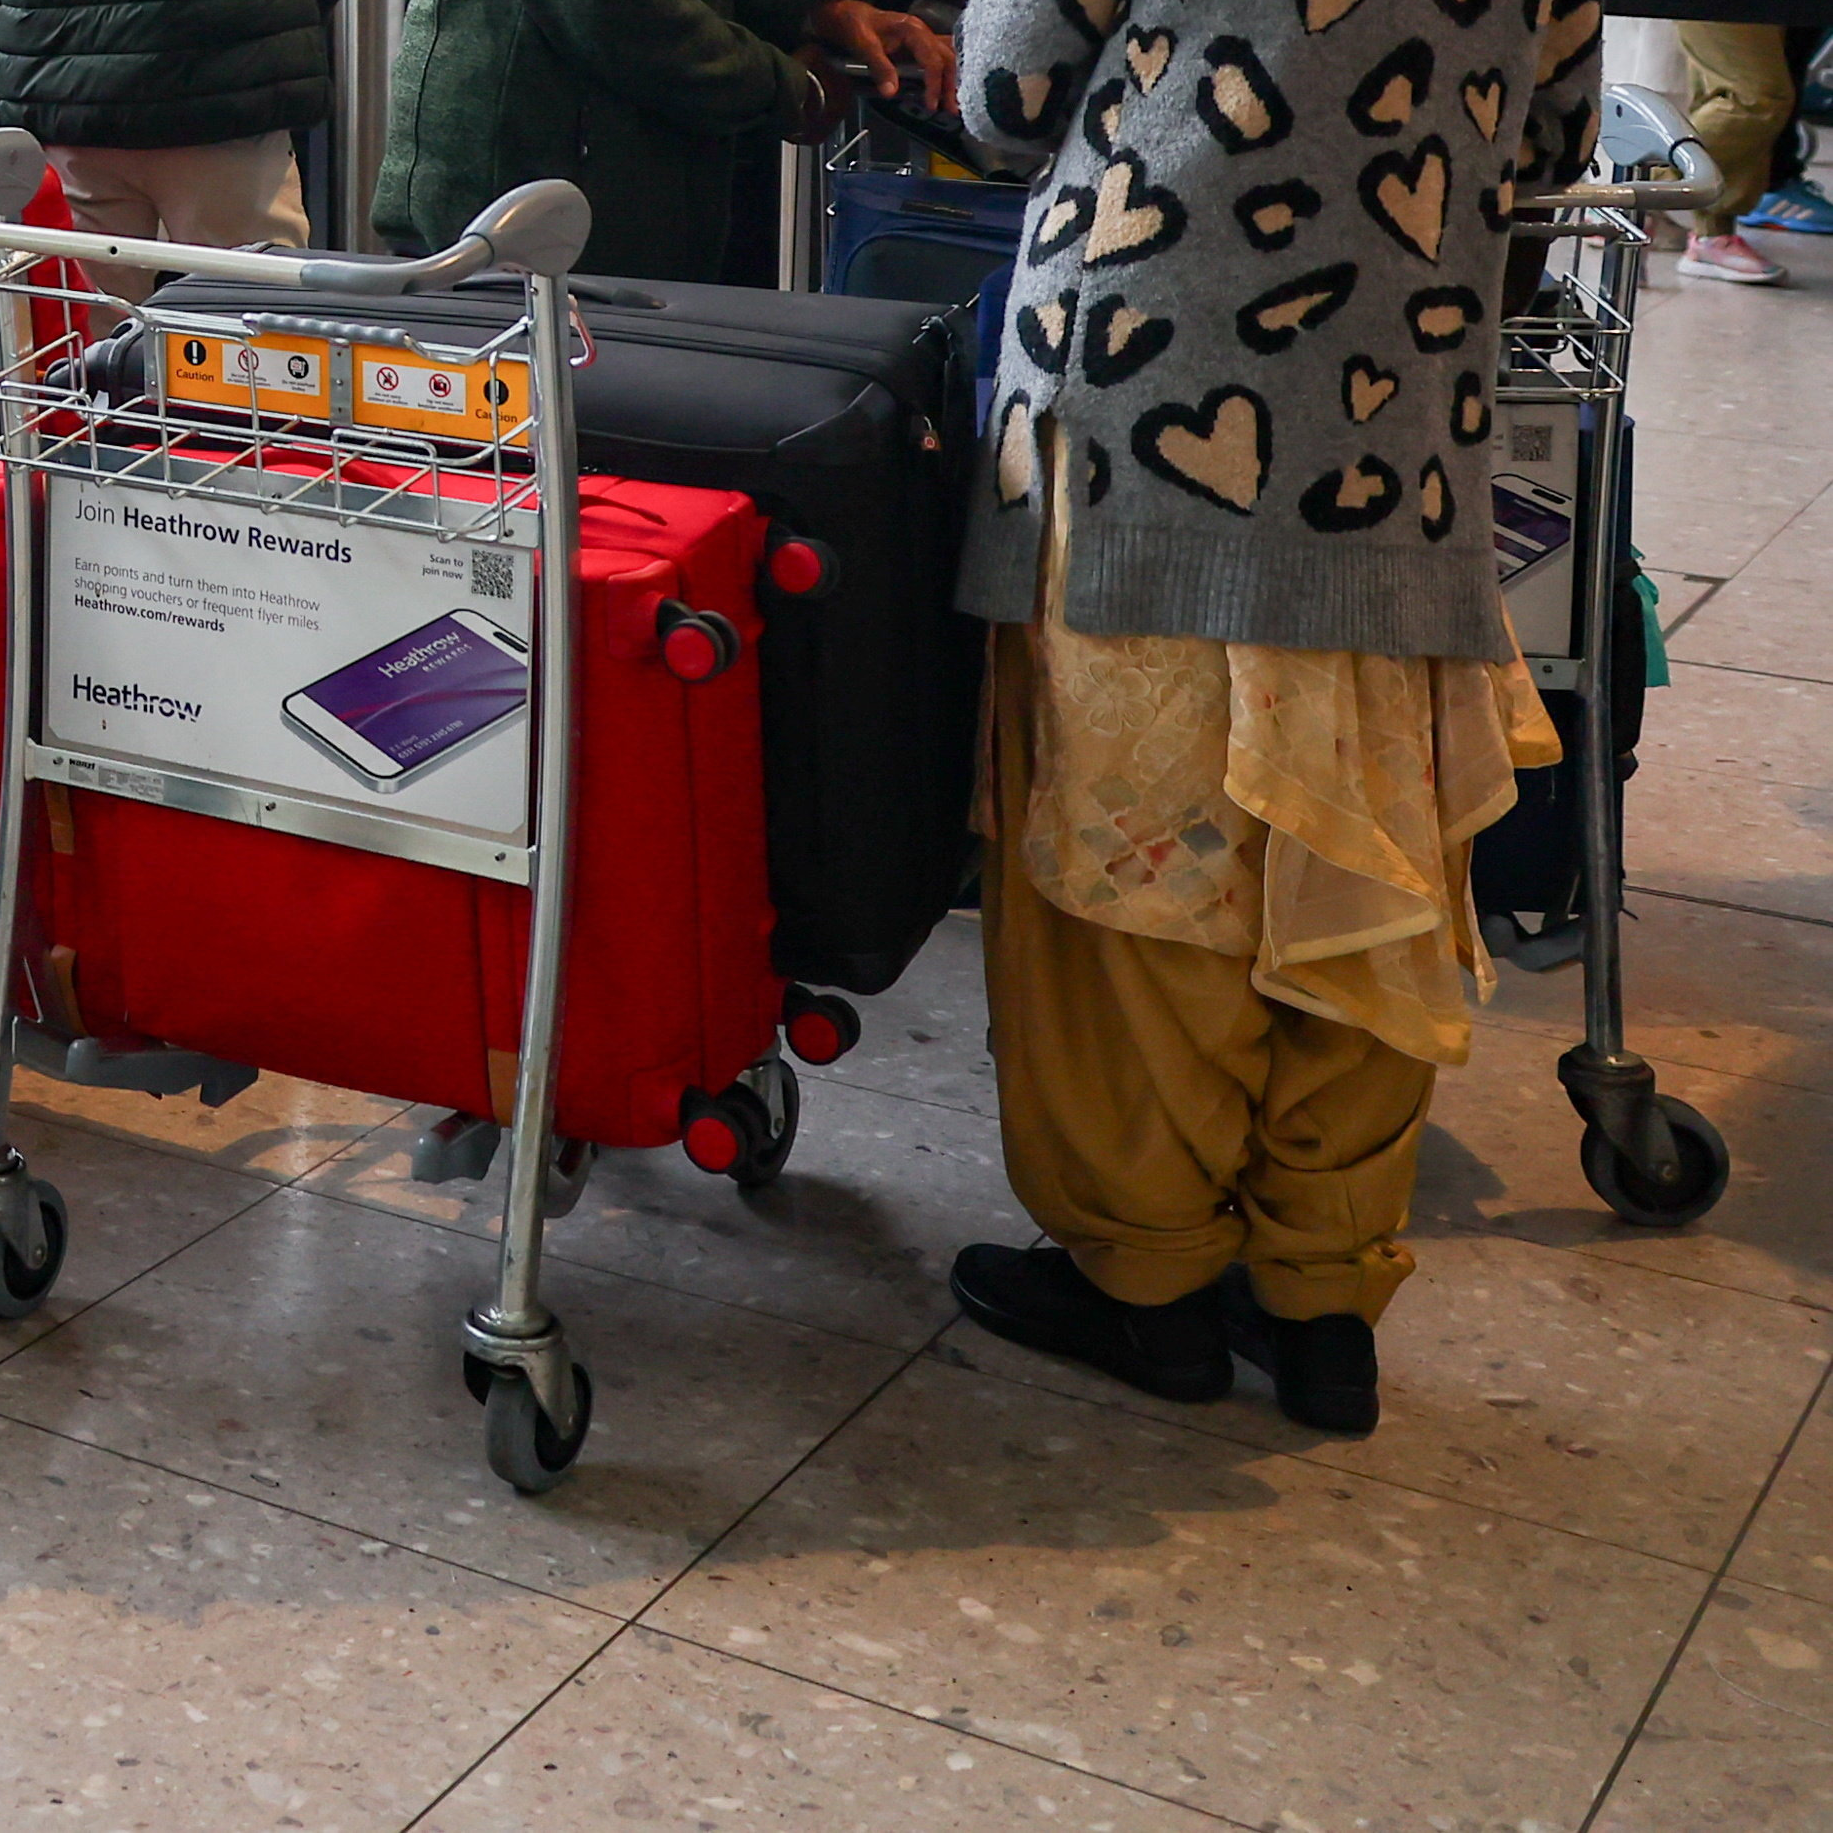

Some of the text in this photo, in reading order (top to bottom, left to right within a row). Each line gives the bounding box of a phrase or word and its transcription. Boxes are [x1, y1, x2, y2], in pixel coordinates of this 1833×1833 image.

[176, 368, 215, 383] Caution
[75, 499, 352, 563] Join Heathrow Rewards
[74, 557, 320, 611] Earn points and turn them into Heathrow
[422, 565, 463, 580] join now
[429, 553, 463, 568] Scan to
[74, 576, 321, 631] shopping vouchers or frequent flyer miles.
[74, 594, 225, 632] Heathrow.com/rewards
[378, 631, 461, 679] Heathrow
[73, 674, 202, 722] Heathrow
